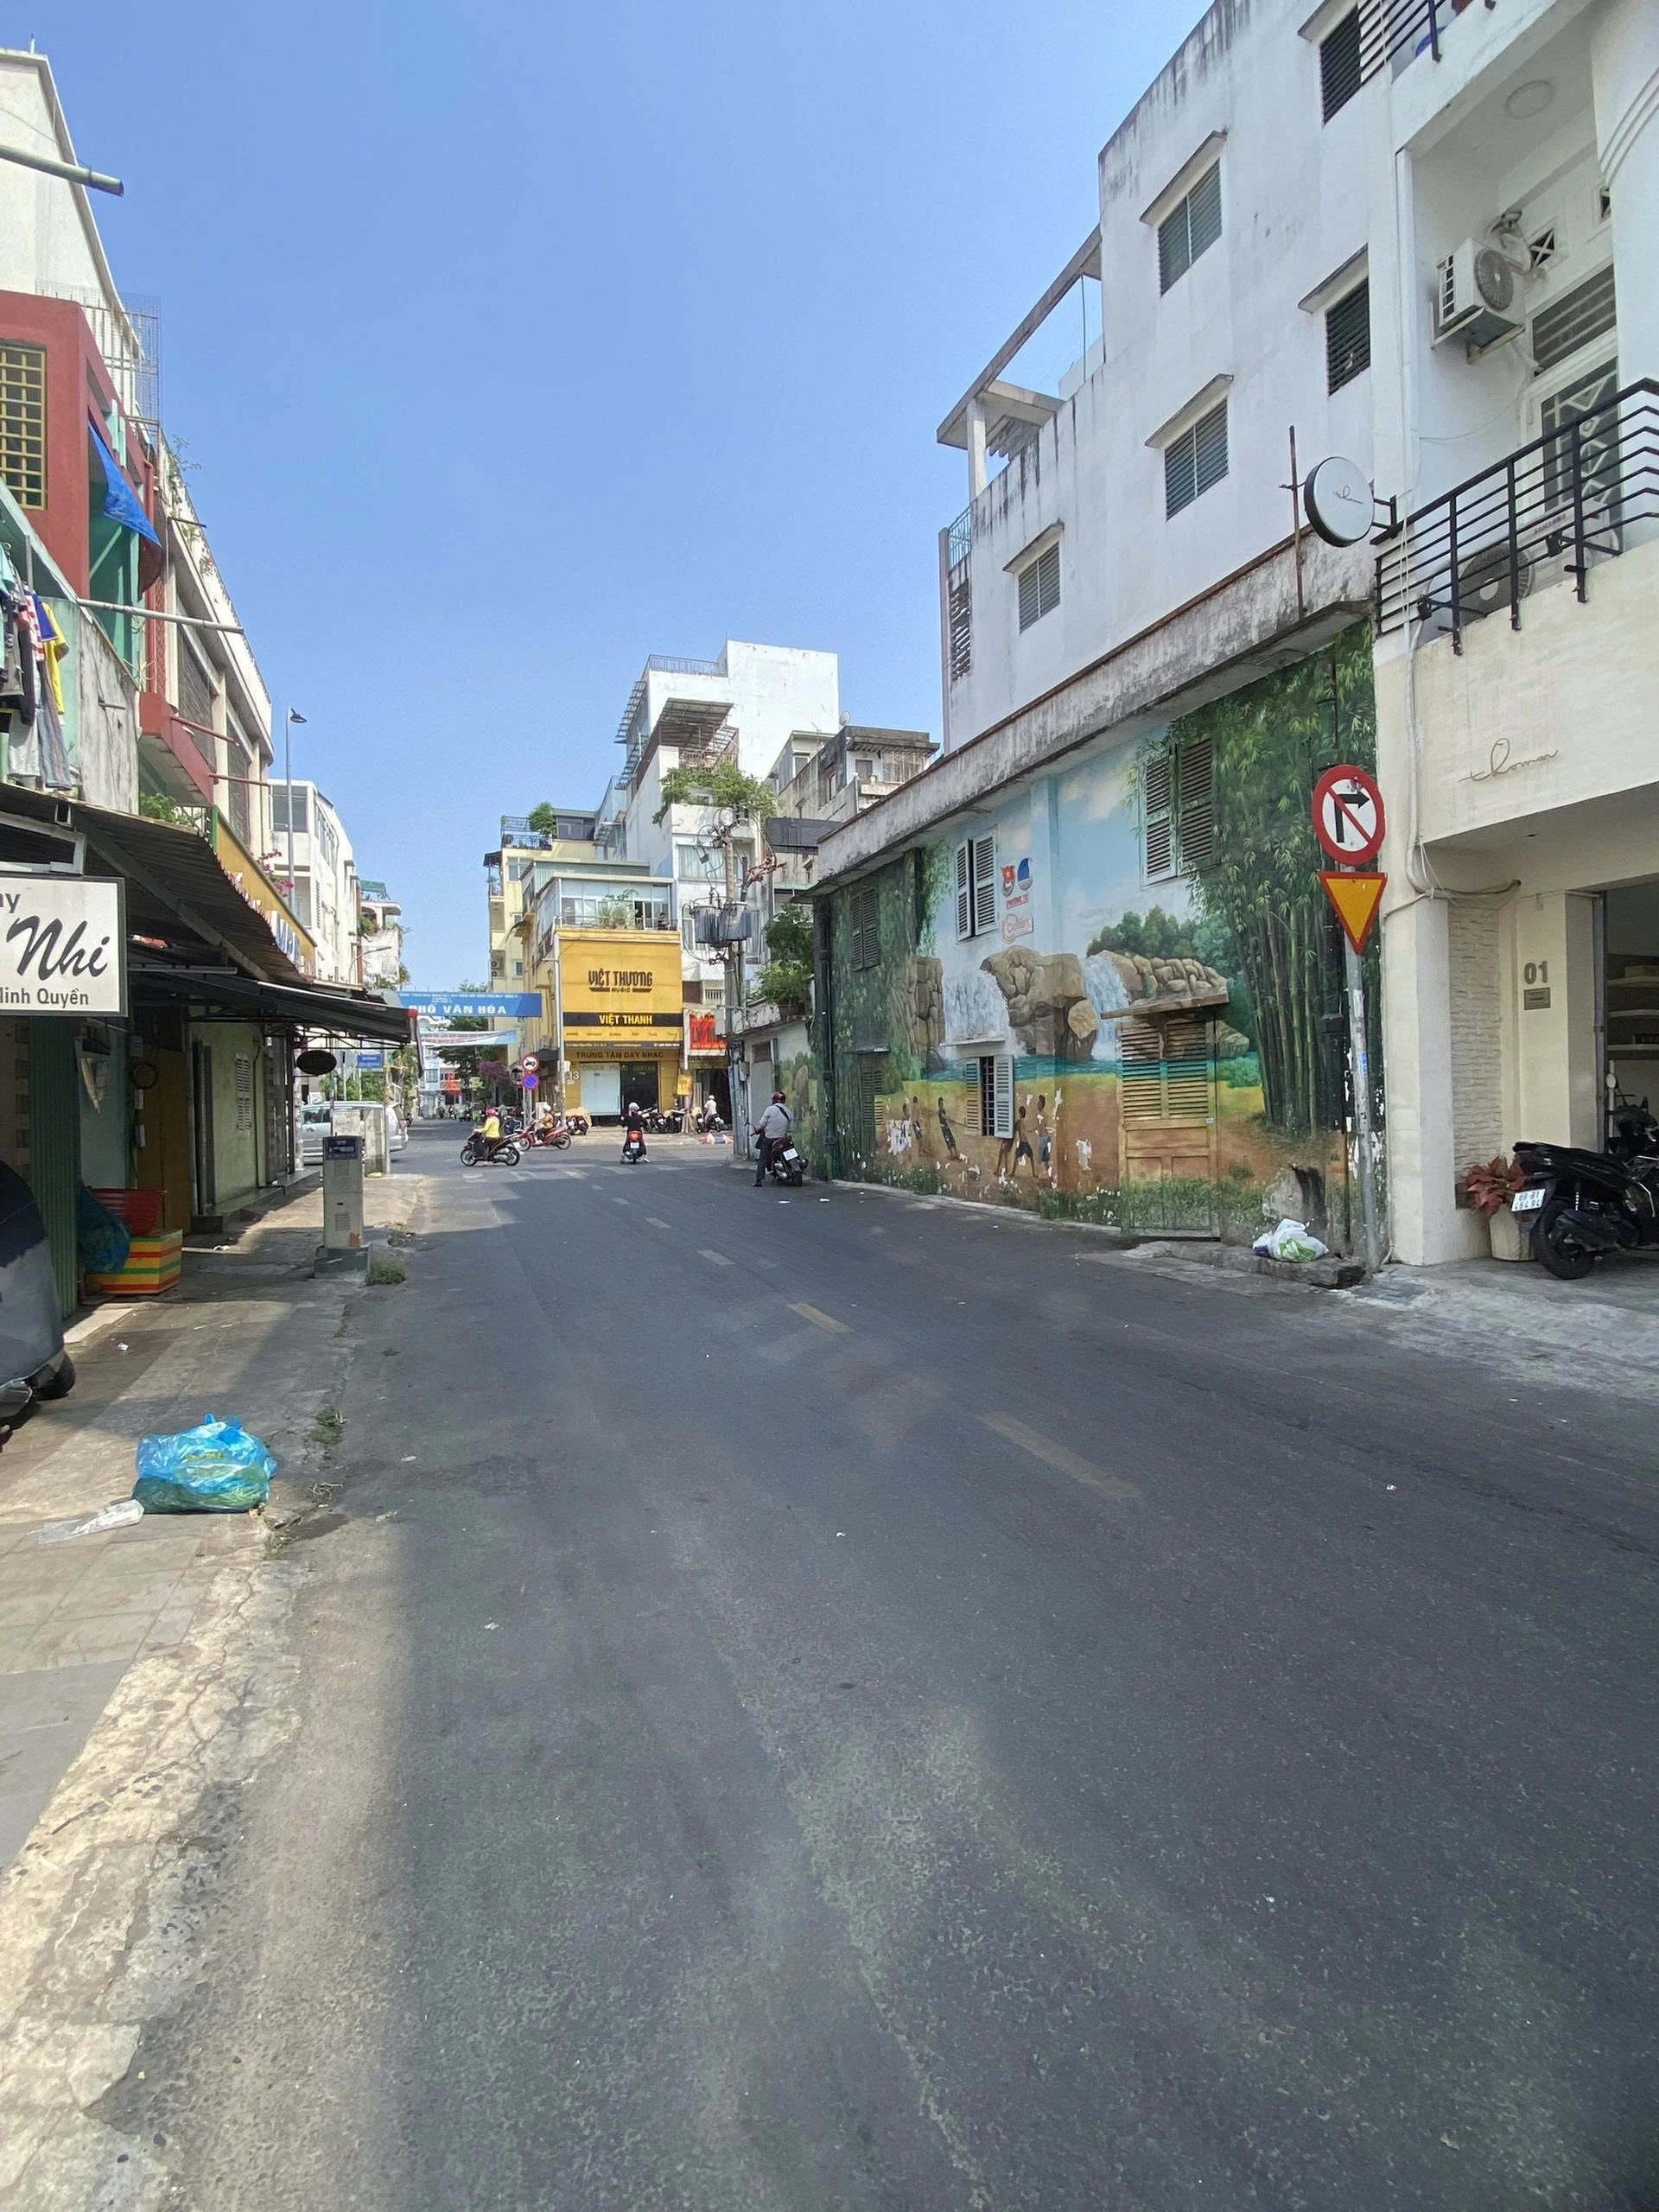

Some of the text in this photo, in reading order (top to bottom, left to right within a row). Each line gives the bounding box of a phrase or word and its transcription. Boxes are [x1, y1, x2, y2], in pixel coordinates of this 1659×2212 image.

[6, 915, 111, 981] Nhi
[1524, 961, 1548, 984] 01
[37, 988, 89, 1008] Quyền
[443, 1004, 473, 1014] VĂN
[599, 1014, 652, 1026] VIỆT THANH
